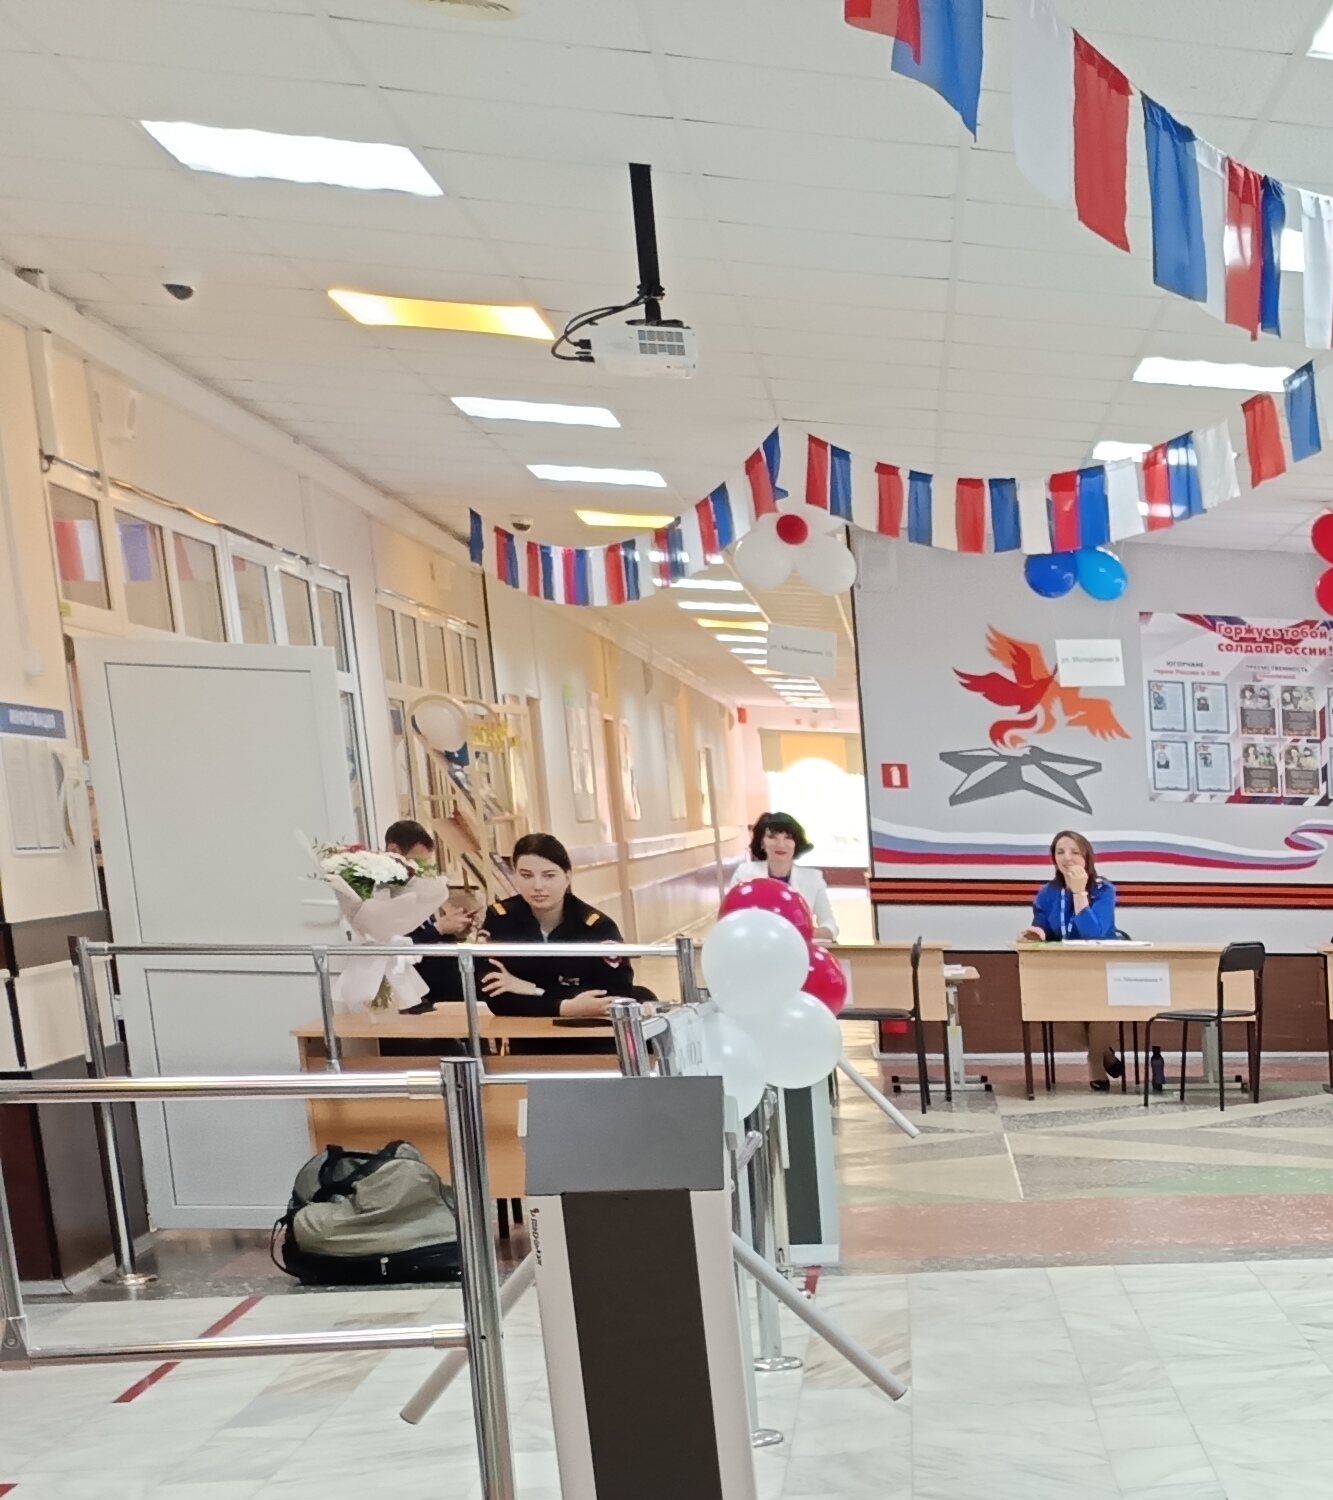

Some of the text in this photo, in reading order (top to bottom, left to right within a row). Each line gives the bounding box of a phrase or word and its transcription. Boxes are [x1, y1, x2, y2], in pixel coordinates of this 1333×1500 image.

[1217, 623, 1332, 641] Горжусь тобой,
[1217, 643, 1333, 656] солдат России!
